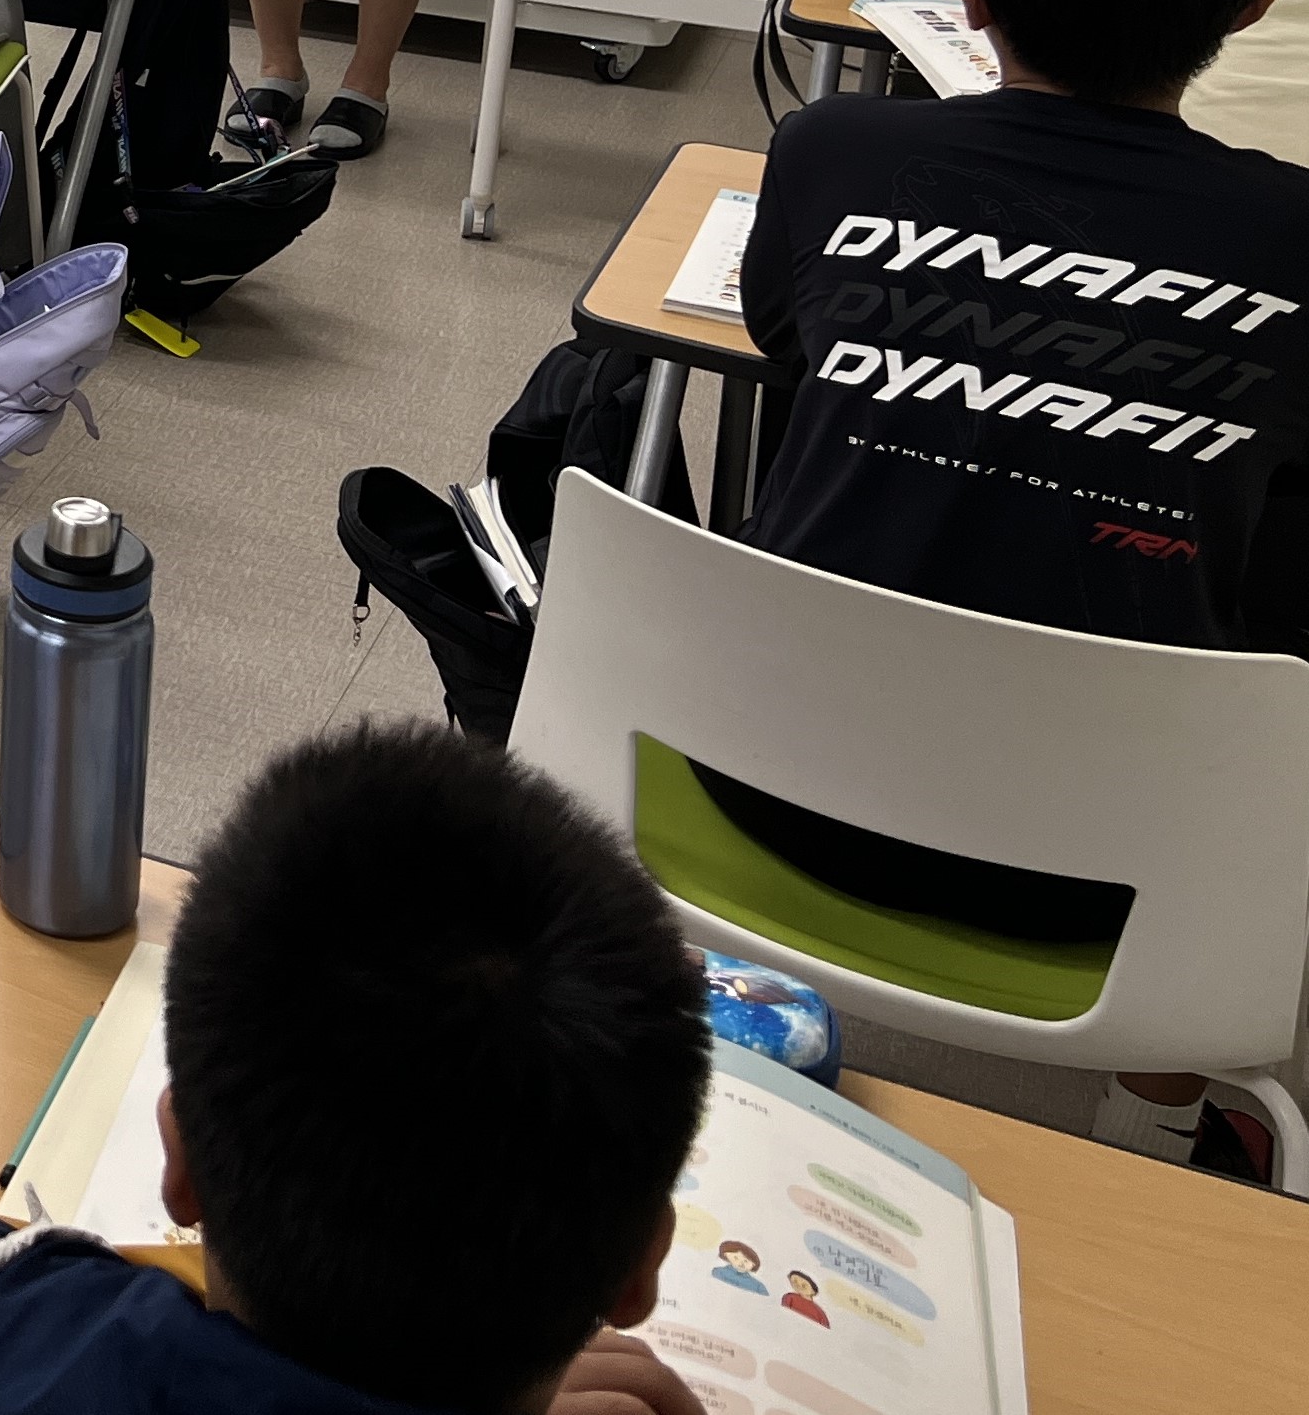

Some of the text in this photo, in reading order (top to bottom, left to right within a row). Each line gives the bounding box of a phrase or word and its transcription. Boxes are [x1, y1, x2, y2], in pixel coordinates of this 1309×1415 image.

[822, 214, 1300, 333] DYNAFIT
[817, 340, 1257, 462] DYNAFIT
[822, 283, 1277, 402] DYNAFIT
[874, 443, 997, 475] ATHLETES
[1009, 471, 1059, 491] FOR
